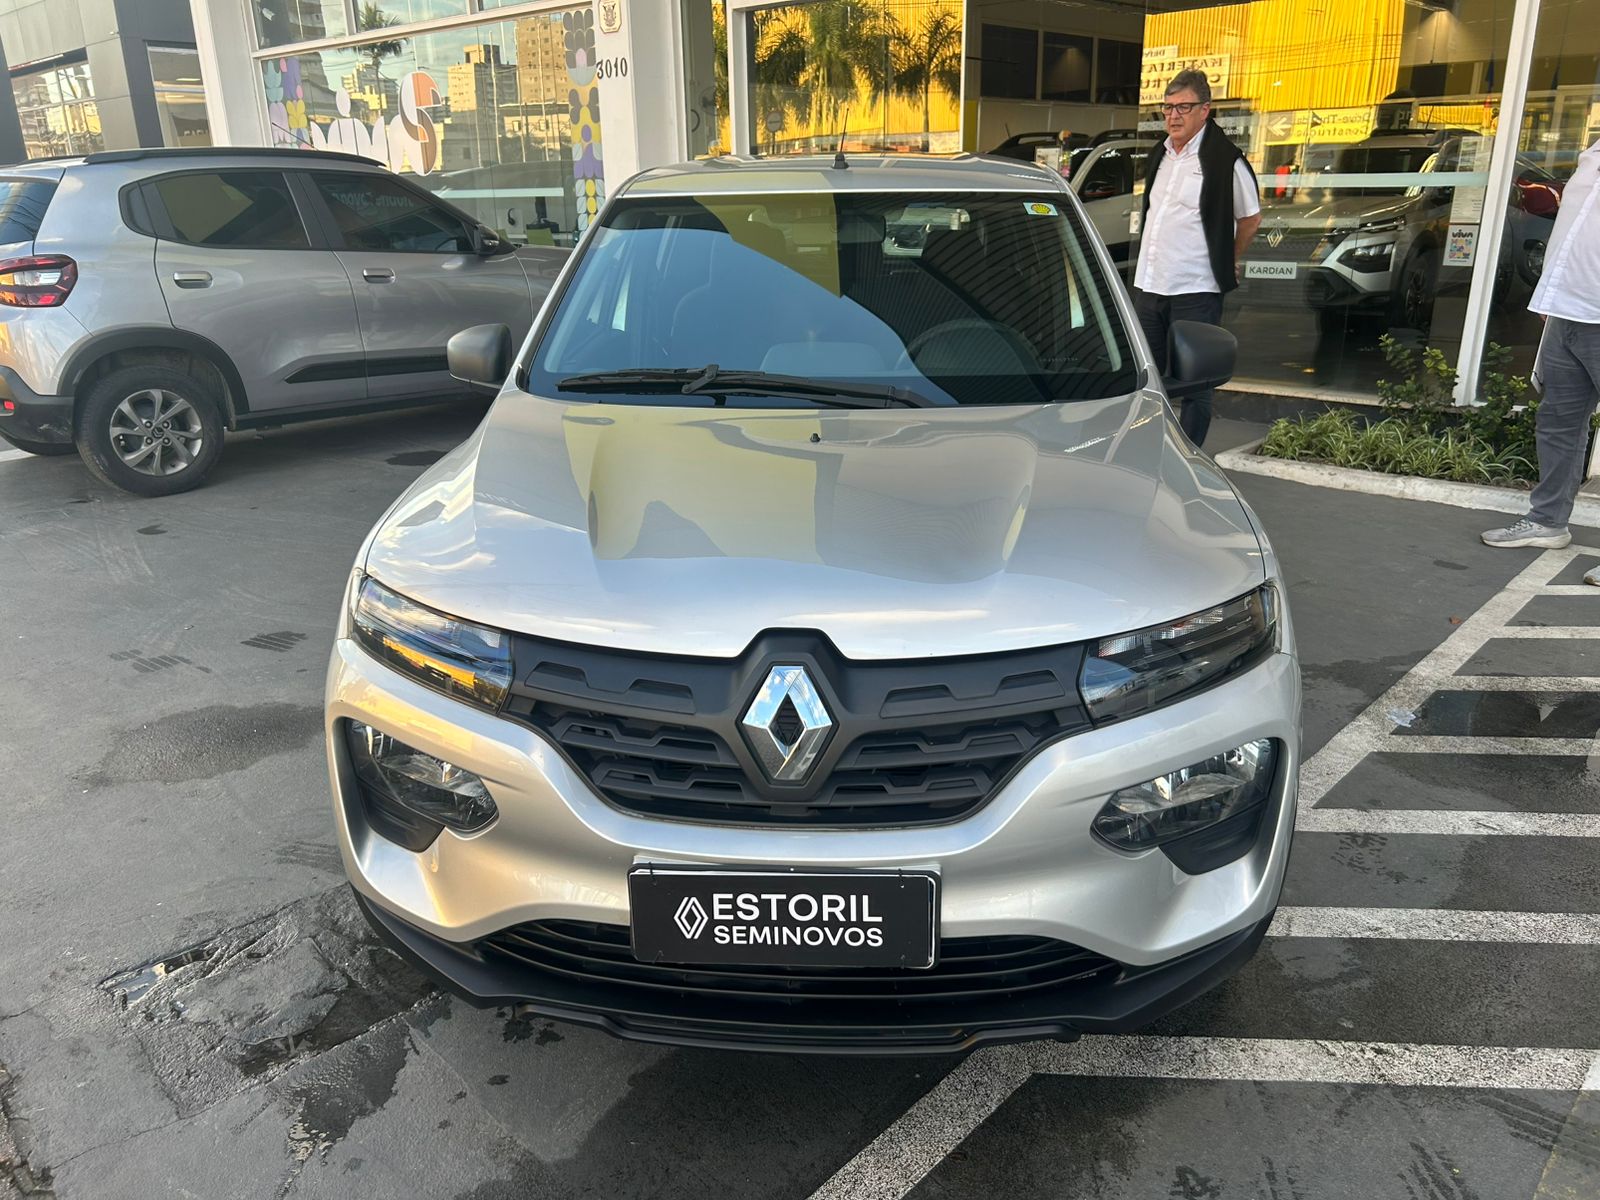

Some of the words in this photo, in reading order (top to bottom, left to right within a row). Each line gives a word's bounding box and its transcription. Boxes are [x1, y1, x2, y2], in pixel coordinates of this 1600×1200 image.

[596, 57, 628, 79] 3010
[1249, 266, 1293, 275] KARDIAN
[712, 893, 883, 922] ESTORIL
[713, 925, 883, 947] SEMINOVOS
